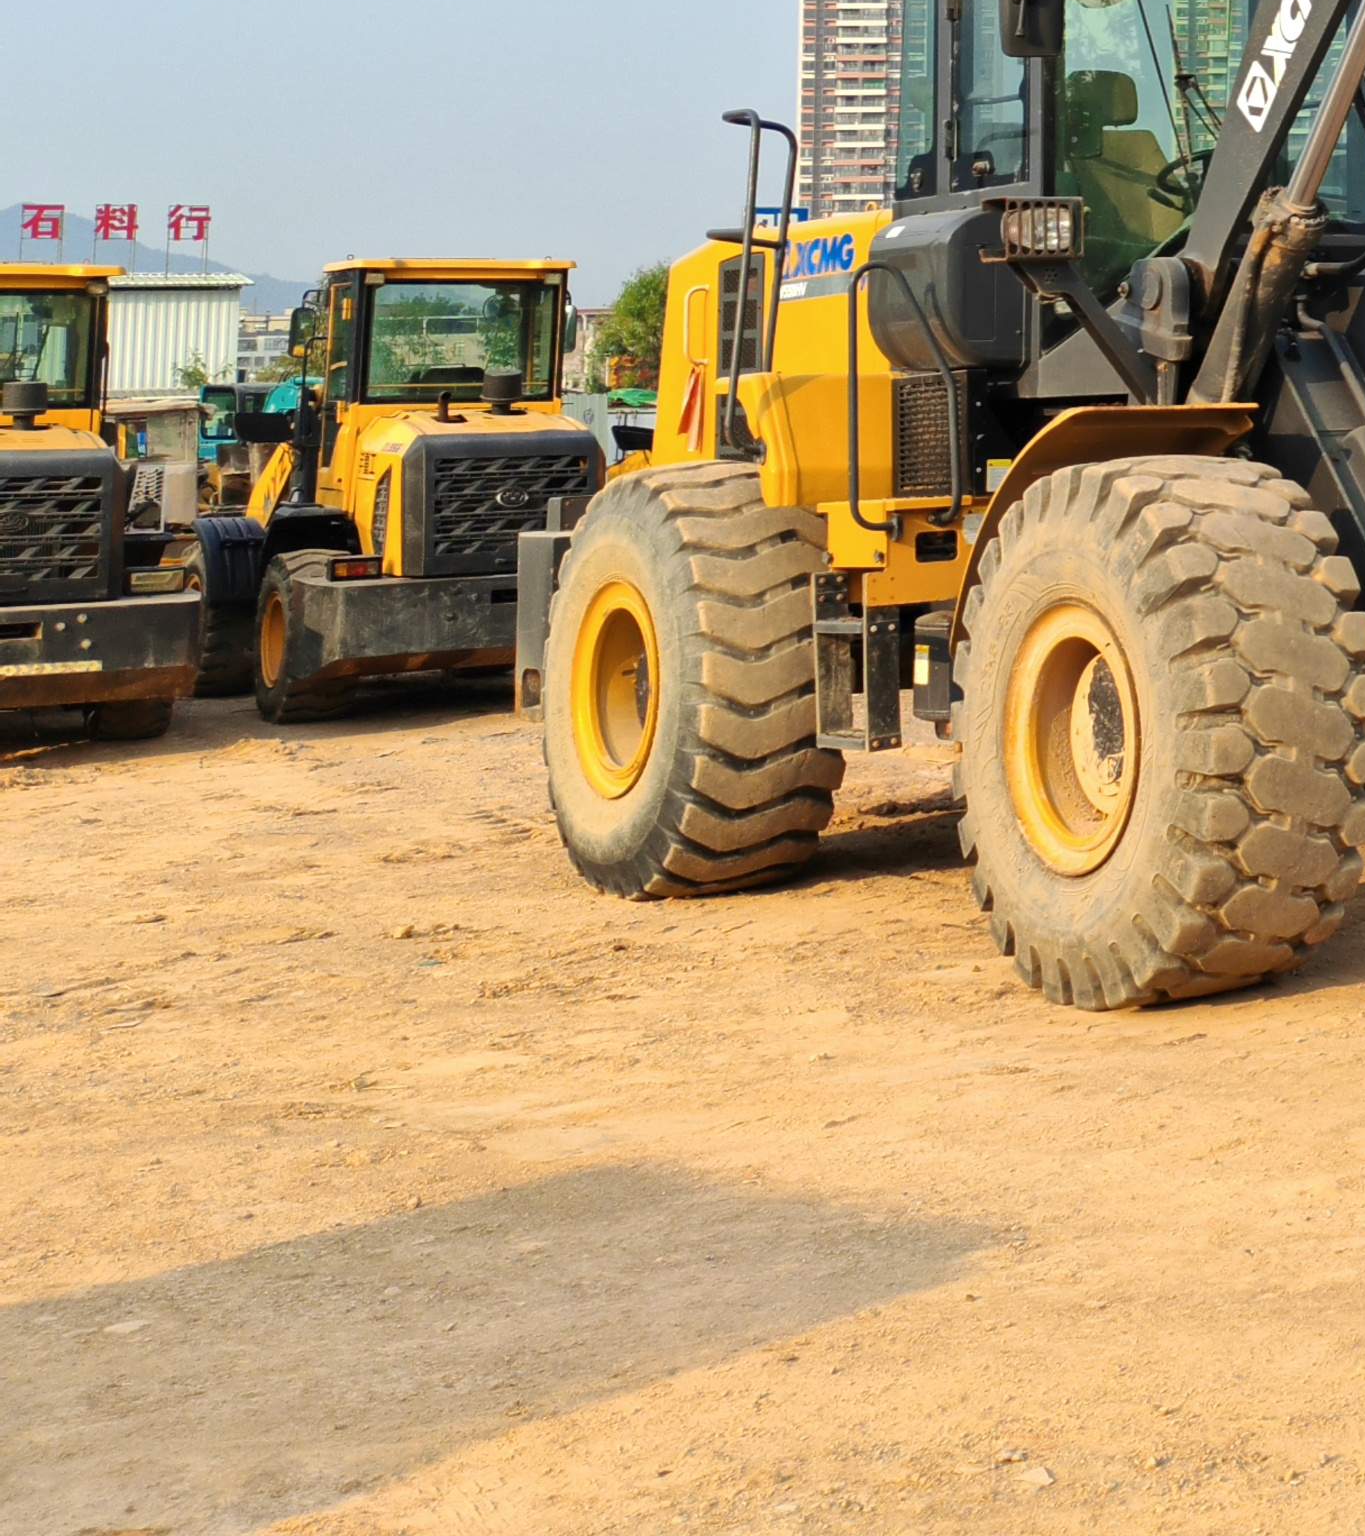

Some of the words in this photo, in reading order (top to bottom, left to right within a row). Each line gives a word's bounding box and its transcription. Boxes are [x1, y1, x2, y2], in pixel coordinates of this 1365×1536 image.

[22, 204, 212, 241] 石料行
[792, 233, 855, 279] XCMG
